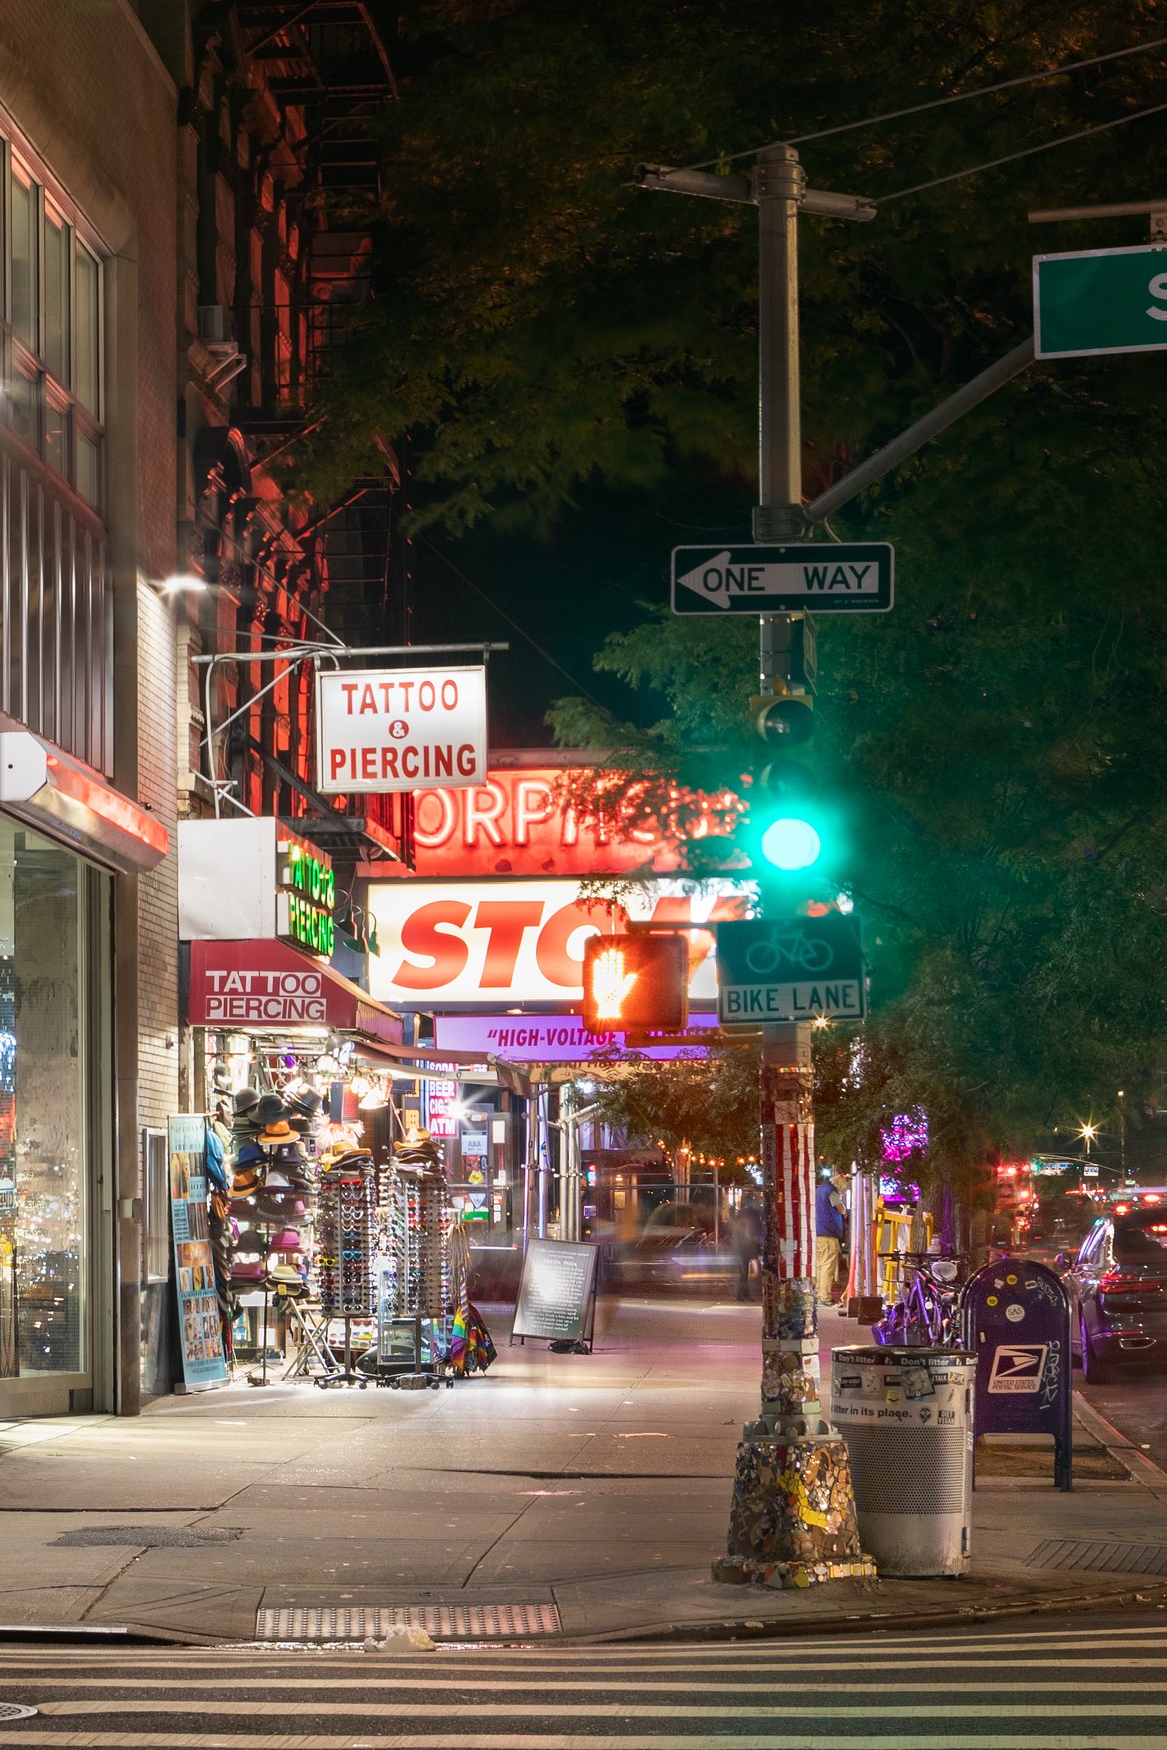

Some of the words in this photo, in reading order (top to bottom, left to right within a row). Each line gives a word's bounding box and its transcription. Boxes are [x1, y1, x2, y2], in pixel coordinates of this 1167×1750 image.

[703, 567, 765, 592] ONE
[803, 565, 871, 591] WAY
[341, 679, 459, 715] TATTOO
[392, 721, 406, 738] &
[330, 744, 476, 781] PIERCING
[289, 892, 335, 957] PIERCING
[205, 970, 322, 994] TATTOO
[206, 997, 325, 1021] PIERCING
[727, 989, 779, 1013] BIKE
[793, 985, 855, 1010] LANE
[429, 1081, 455, 1097] BEER
[430, 1118, 455, 1135] ATM
[901, 1358, 926, 1366] Don't
[850, 1406, 858, 1415] in
[861, 1407, 874, 1417] its
[878, 1408, 913, 1419] place.
